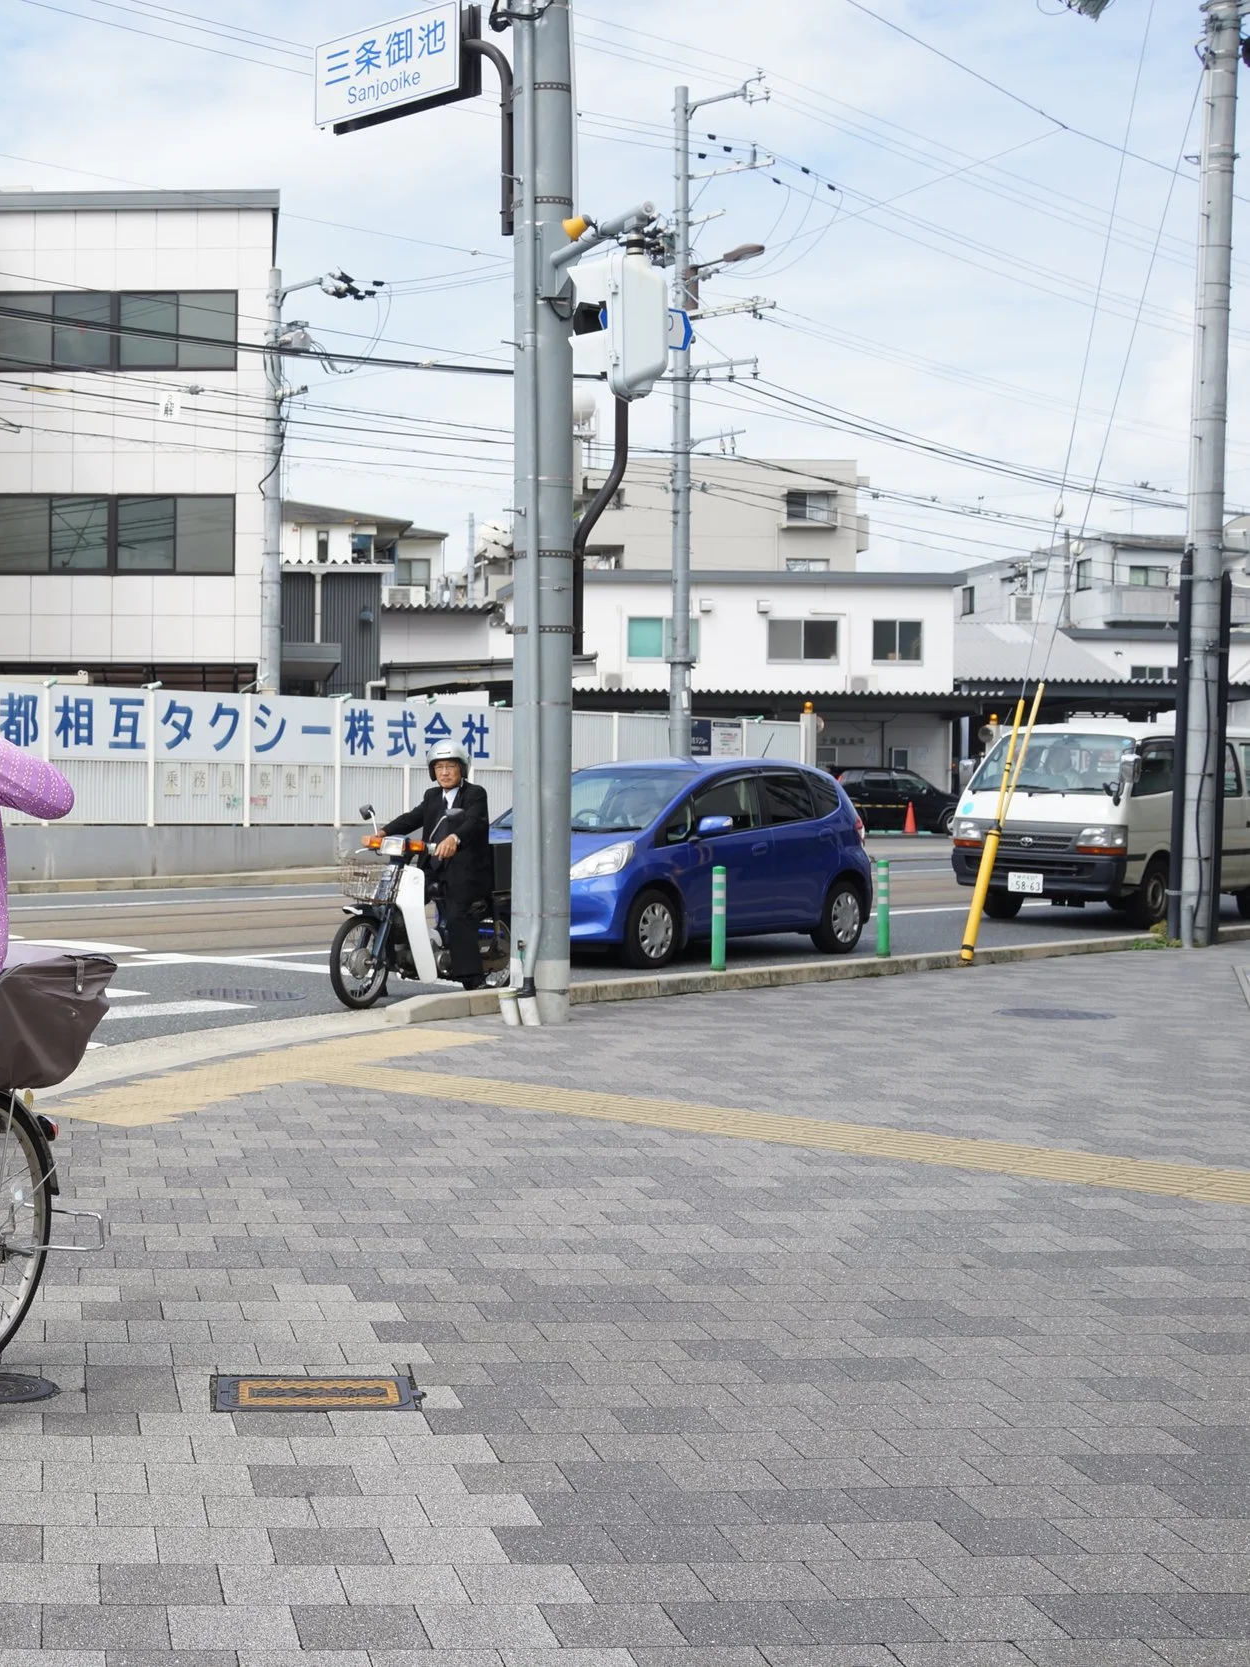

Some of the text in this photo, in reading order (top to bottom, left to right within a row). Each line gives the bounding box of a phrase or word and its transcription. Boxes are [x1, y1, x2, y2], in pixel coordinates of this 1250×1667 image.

[325, 19, 446, 86] 三条御池
[347, 71, 421, 105] Sanjooike
